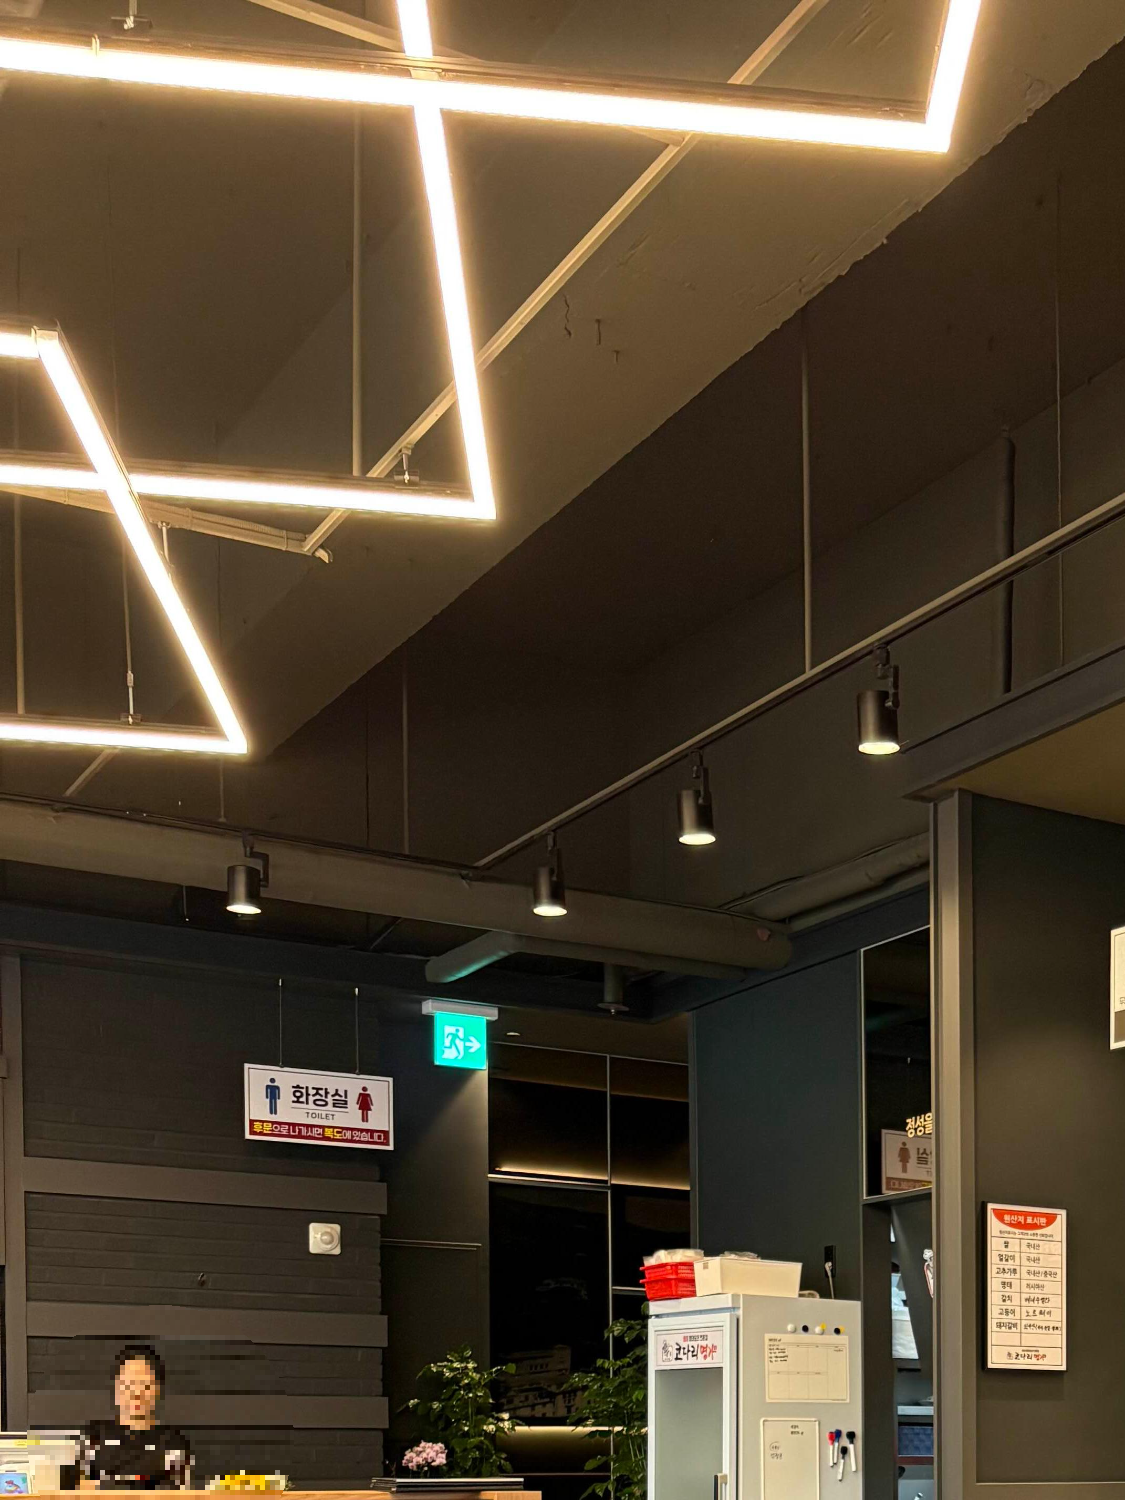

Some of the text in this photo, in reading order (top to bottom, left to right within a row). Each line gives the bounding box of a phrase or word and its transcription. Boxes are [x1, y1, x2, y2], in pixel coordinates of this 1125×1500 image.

[291, 1083, 349, 1109] 화장실
[305, 1111, 336, 1121] TOILET
[253, 1122, 289, 1135] 후문으로
[290, 1125, 323, 1138] 나가시면
[323, 1127, 352, 1140] 복도에
[1003, 1214, 1047, 1226] 원산지 표시판
[1026, 1242, 1041, 1250] 국내산
[1026, 1256, 1041, 1264] 국내산
[998, 1308, 1016, 1316] 고등어
